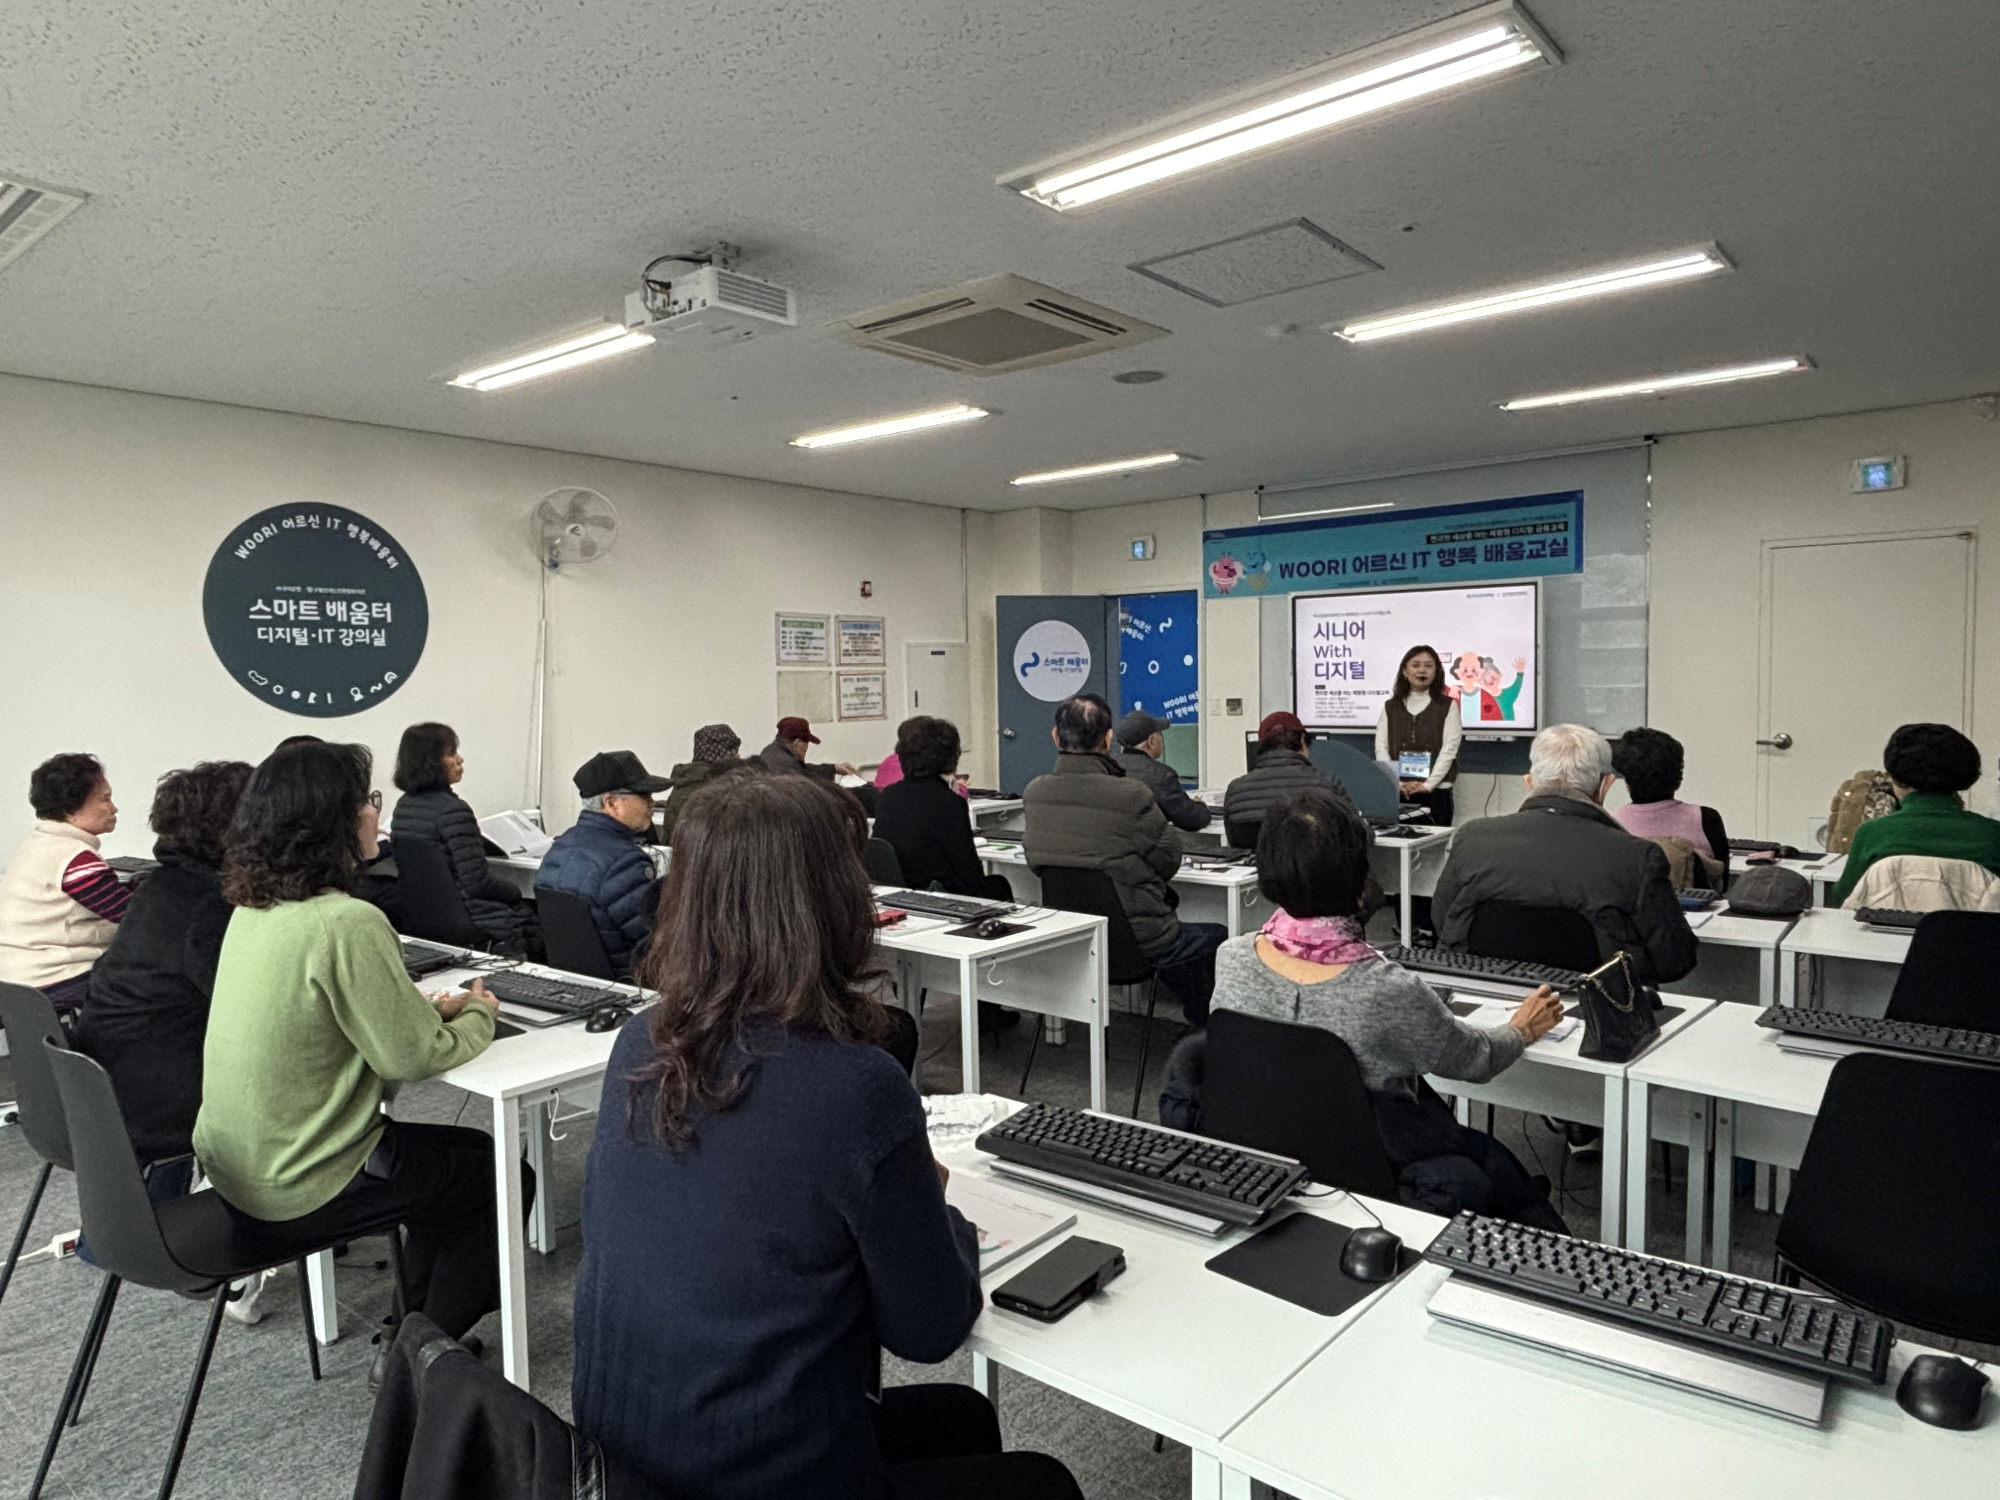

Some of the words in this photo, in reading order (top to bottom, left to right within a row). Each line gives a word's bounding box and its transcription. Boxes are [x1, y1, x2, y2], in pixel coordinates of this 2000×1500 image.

[234, 523, 279, 560] WOORI
[281, 514, 321, 530] 어르신
[326, 517, 342, 530] IT
[346, 522, 400, 570] 행복배움터
[1278, 558, 1347, 580] WOORI
[1352, 552, 1407, 573] 어르신
[1412, 551, 1431, 569] IT
[1436, 545, 1477, 568] 행복
[1483, 537, 1569, 563] 배움교실
[248, 598, 322, 621] 스마트
[325, 600, 393, 626] 배움터
[338, 628, 387, 647] 강의실
[1313, 620, 1366, 641] 시니어
[1313, 644, 1353, 659] With
[1043, 657, 1065, 667] 스마트
[1067, 656, 1089, 668] 배움터
[1314, 660, 1366, 681] 디지털
[1163, 694, 1187, 709] WOORI
[1165, 710, 1174, 720] IT
